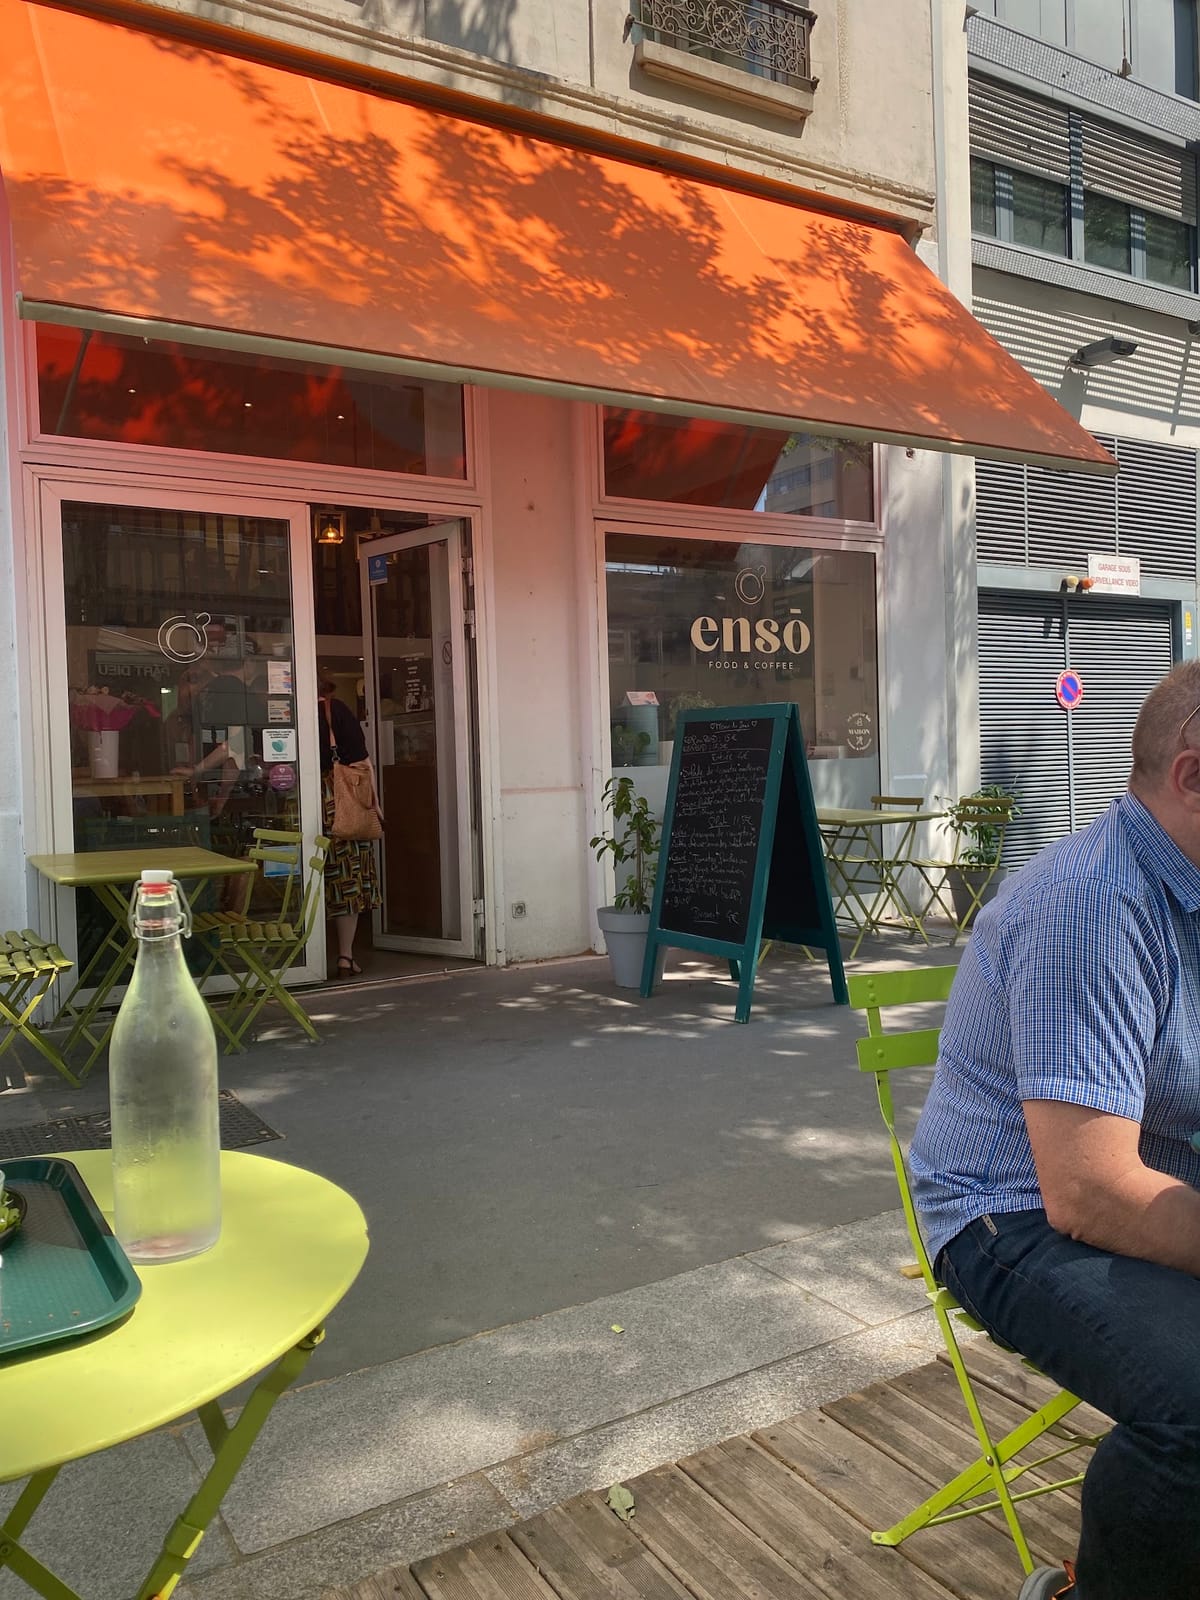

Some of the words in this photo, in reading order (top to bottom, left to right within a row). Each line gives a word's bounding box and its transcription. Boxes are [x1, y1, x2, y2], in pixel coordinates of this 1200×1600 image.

[1098, 563, 1117, 572] GARAGE
[1118, 565, 1131, 573] SOUS
[690, 608, 811, 654] ensō
[708, 661, 738, 669] FOOD
[744, 661, 749, 669] &
[754, 661, 794, 670] COFFEE
